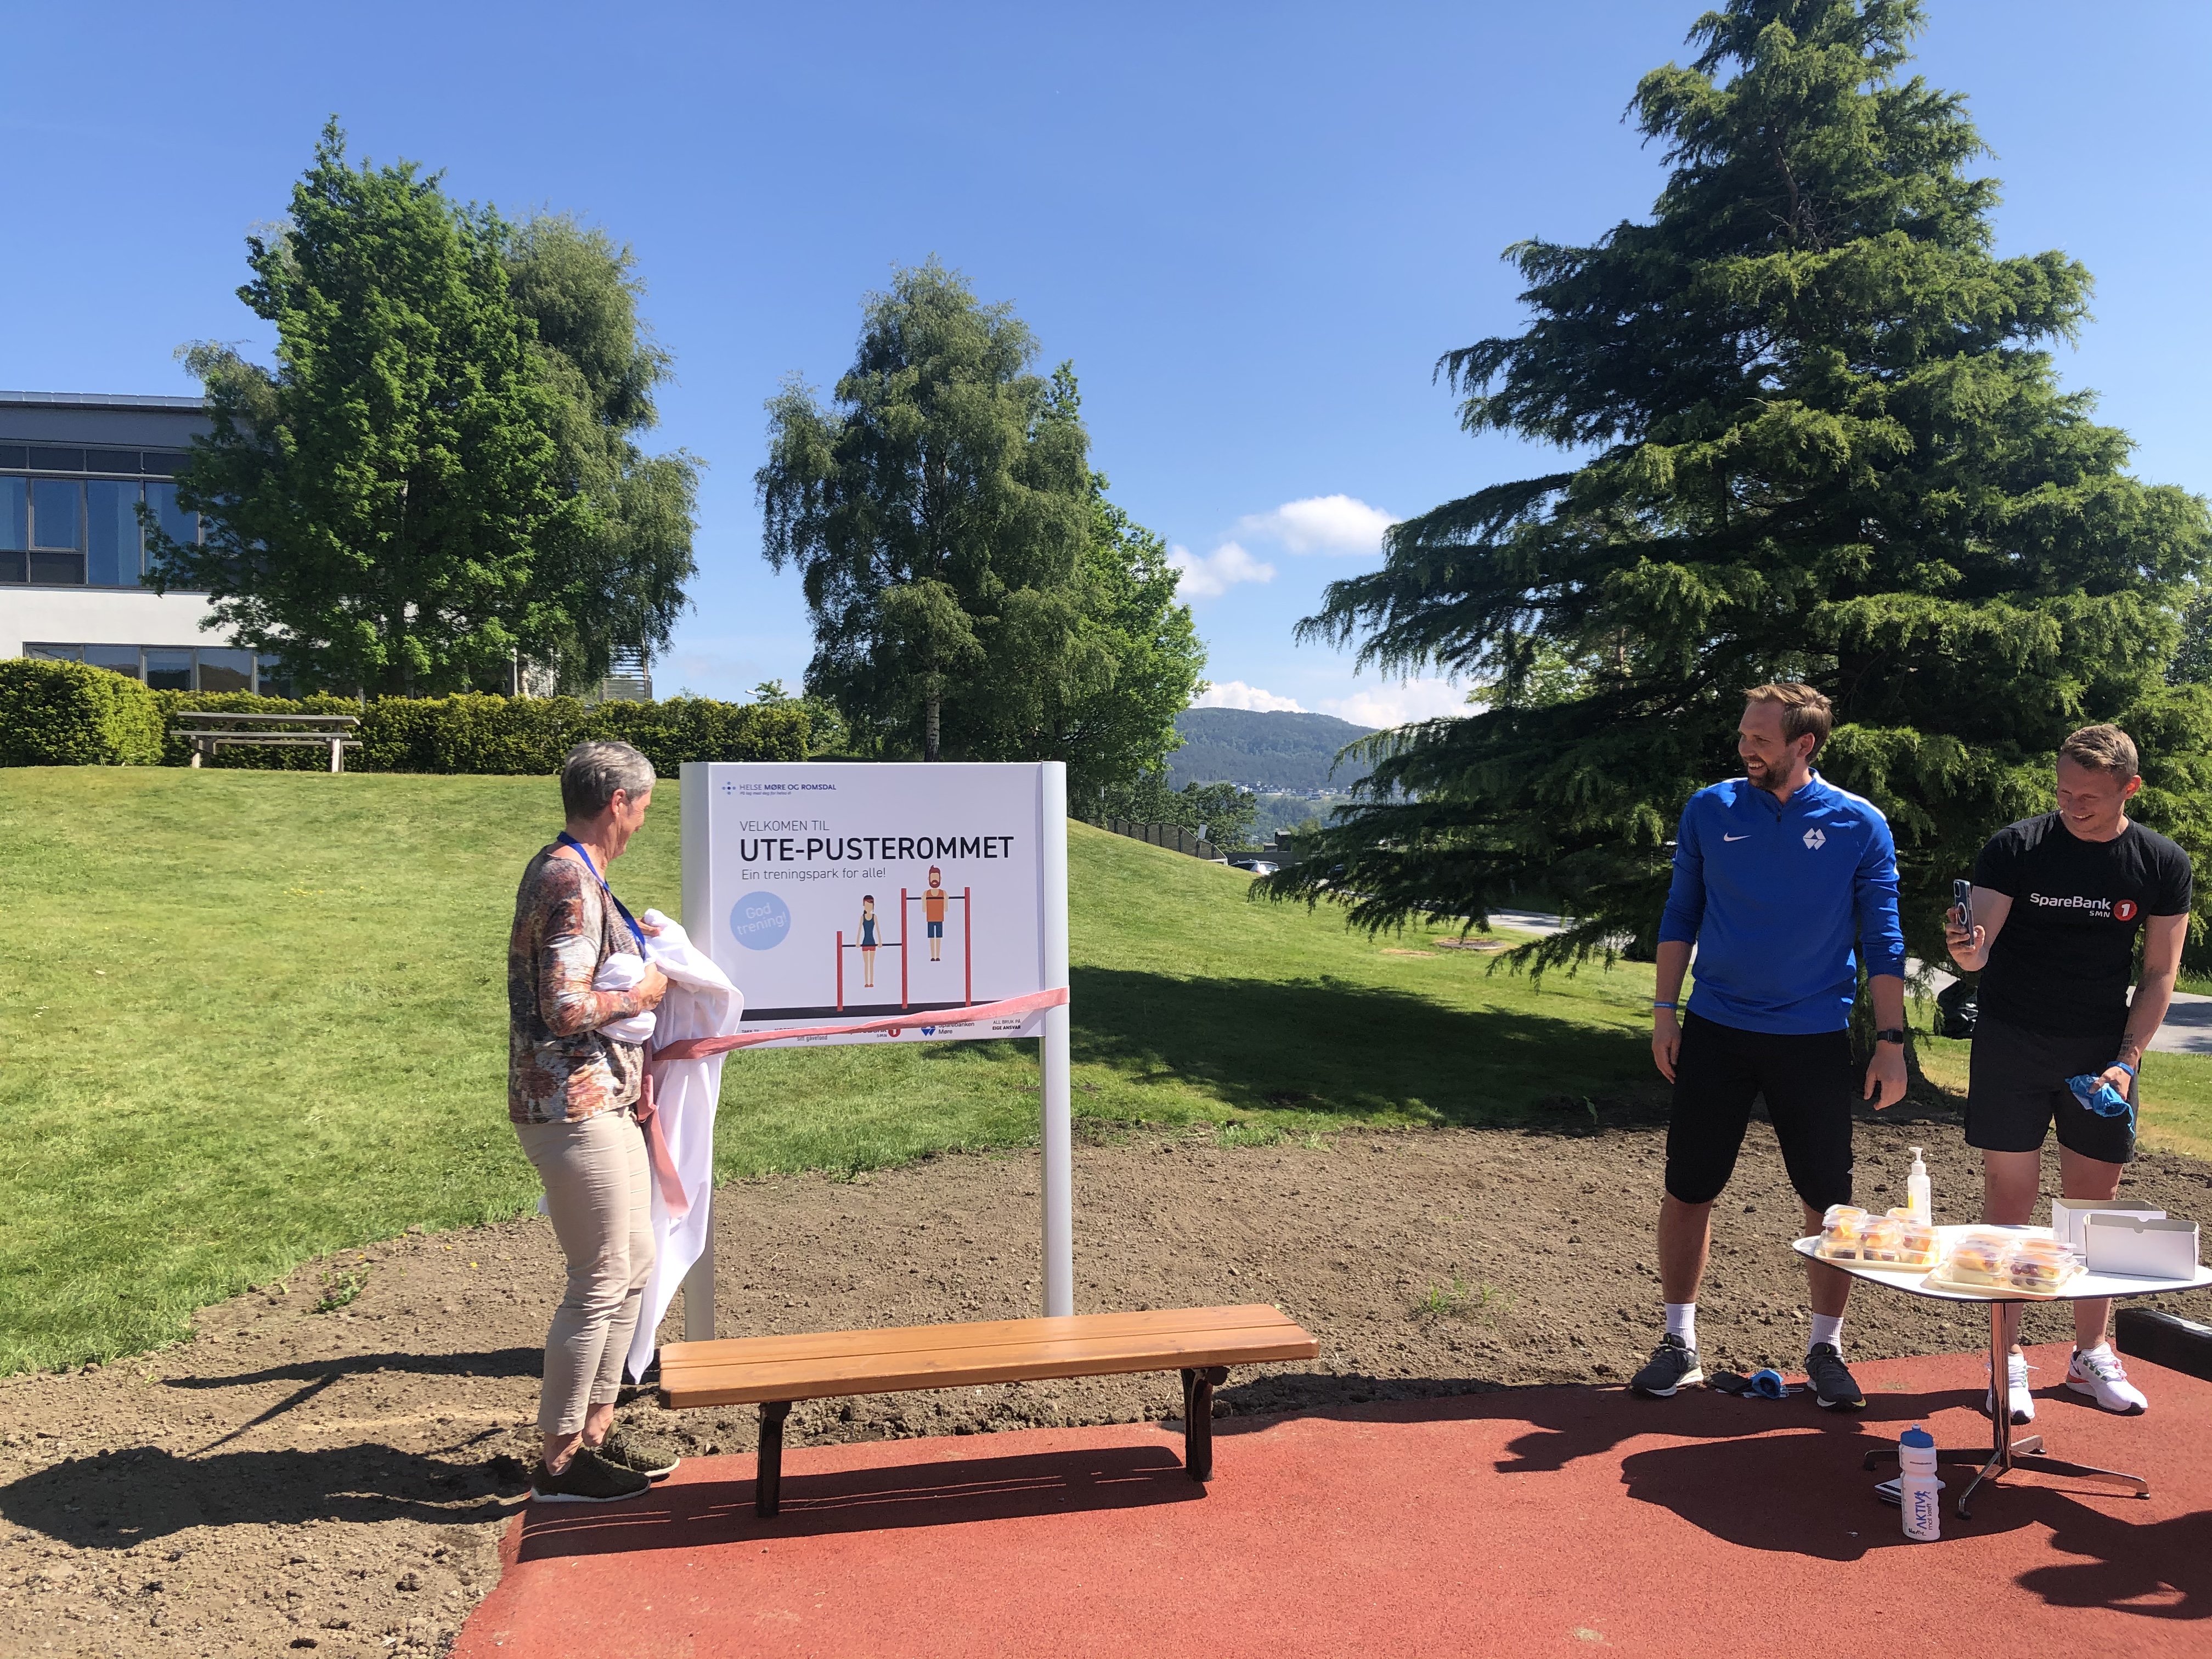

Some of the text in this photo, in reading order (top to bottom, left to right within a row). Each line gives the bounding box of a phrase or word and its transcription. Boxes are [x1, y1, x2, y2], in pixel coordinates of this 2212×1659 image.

[740, 820, 830, 831] VELKOMEN TIL
[741, 836, 1014, 862] UTE-PUSTEROMMET
[742, 867, 886, 882] Ein treningspark for alle!
[746, 902, 772, 919] God
[2030, 893, 2130, 917] SpareBank 1
[737, 911, 787, 935] trening!
[1915, 1496, 1927, 1530] AKTIV
